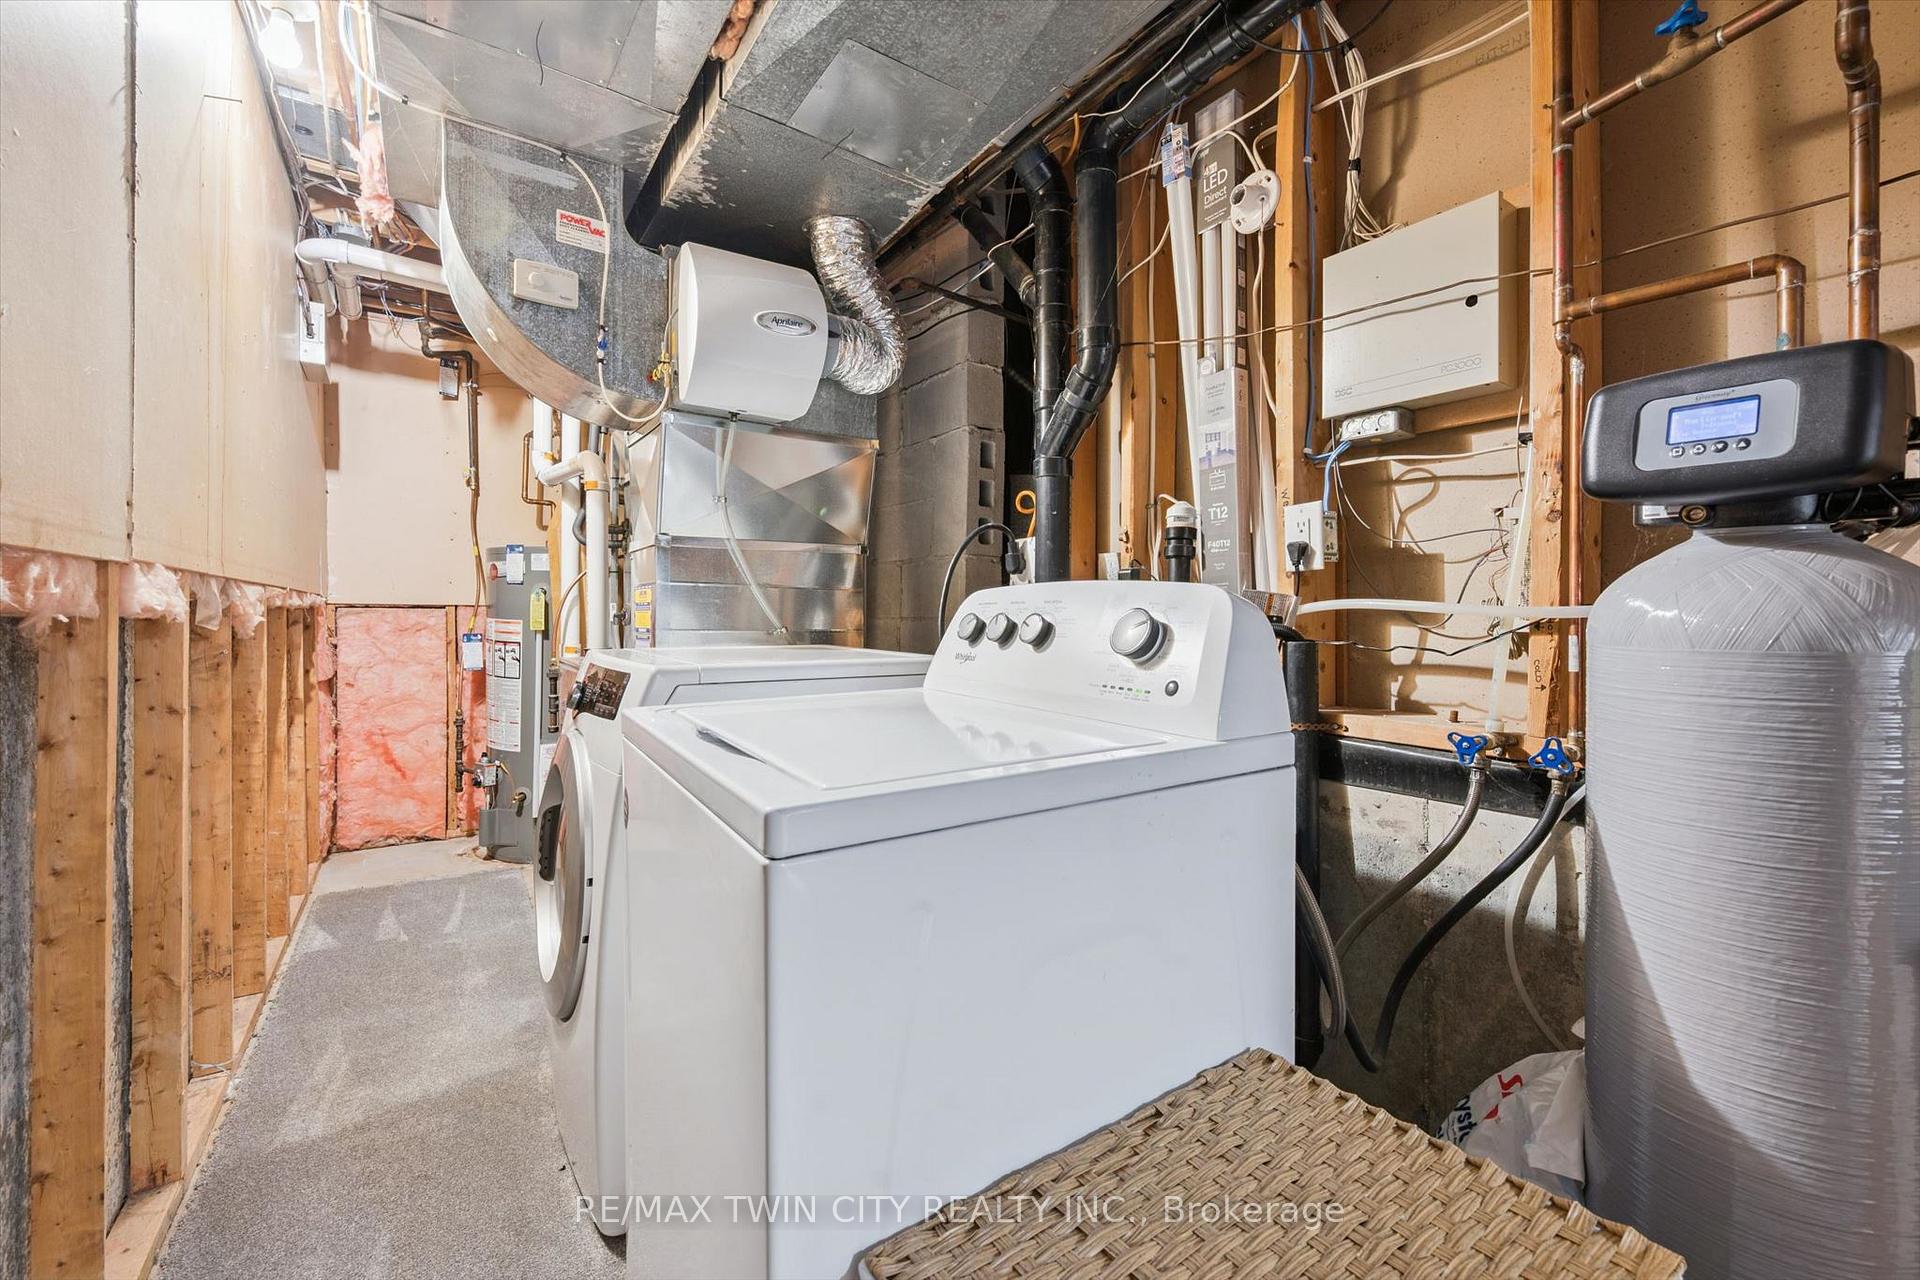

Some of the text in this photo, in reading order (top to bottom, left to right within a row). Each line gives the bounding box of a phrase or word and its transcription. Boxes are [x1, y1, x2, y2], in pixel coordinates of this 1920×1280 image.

[1203, 168, 1228, 193] LED
[1204, 186, 1227, 205] Direct
[560, 213, 591, 227] POWER
[770, 315, 804, 328] Aprilaire
[1335, 387, 1353, 399] DSC
[1208, 505, 1228, 520] T12
[1533, 660, 1542, 683] COLD
